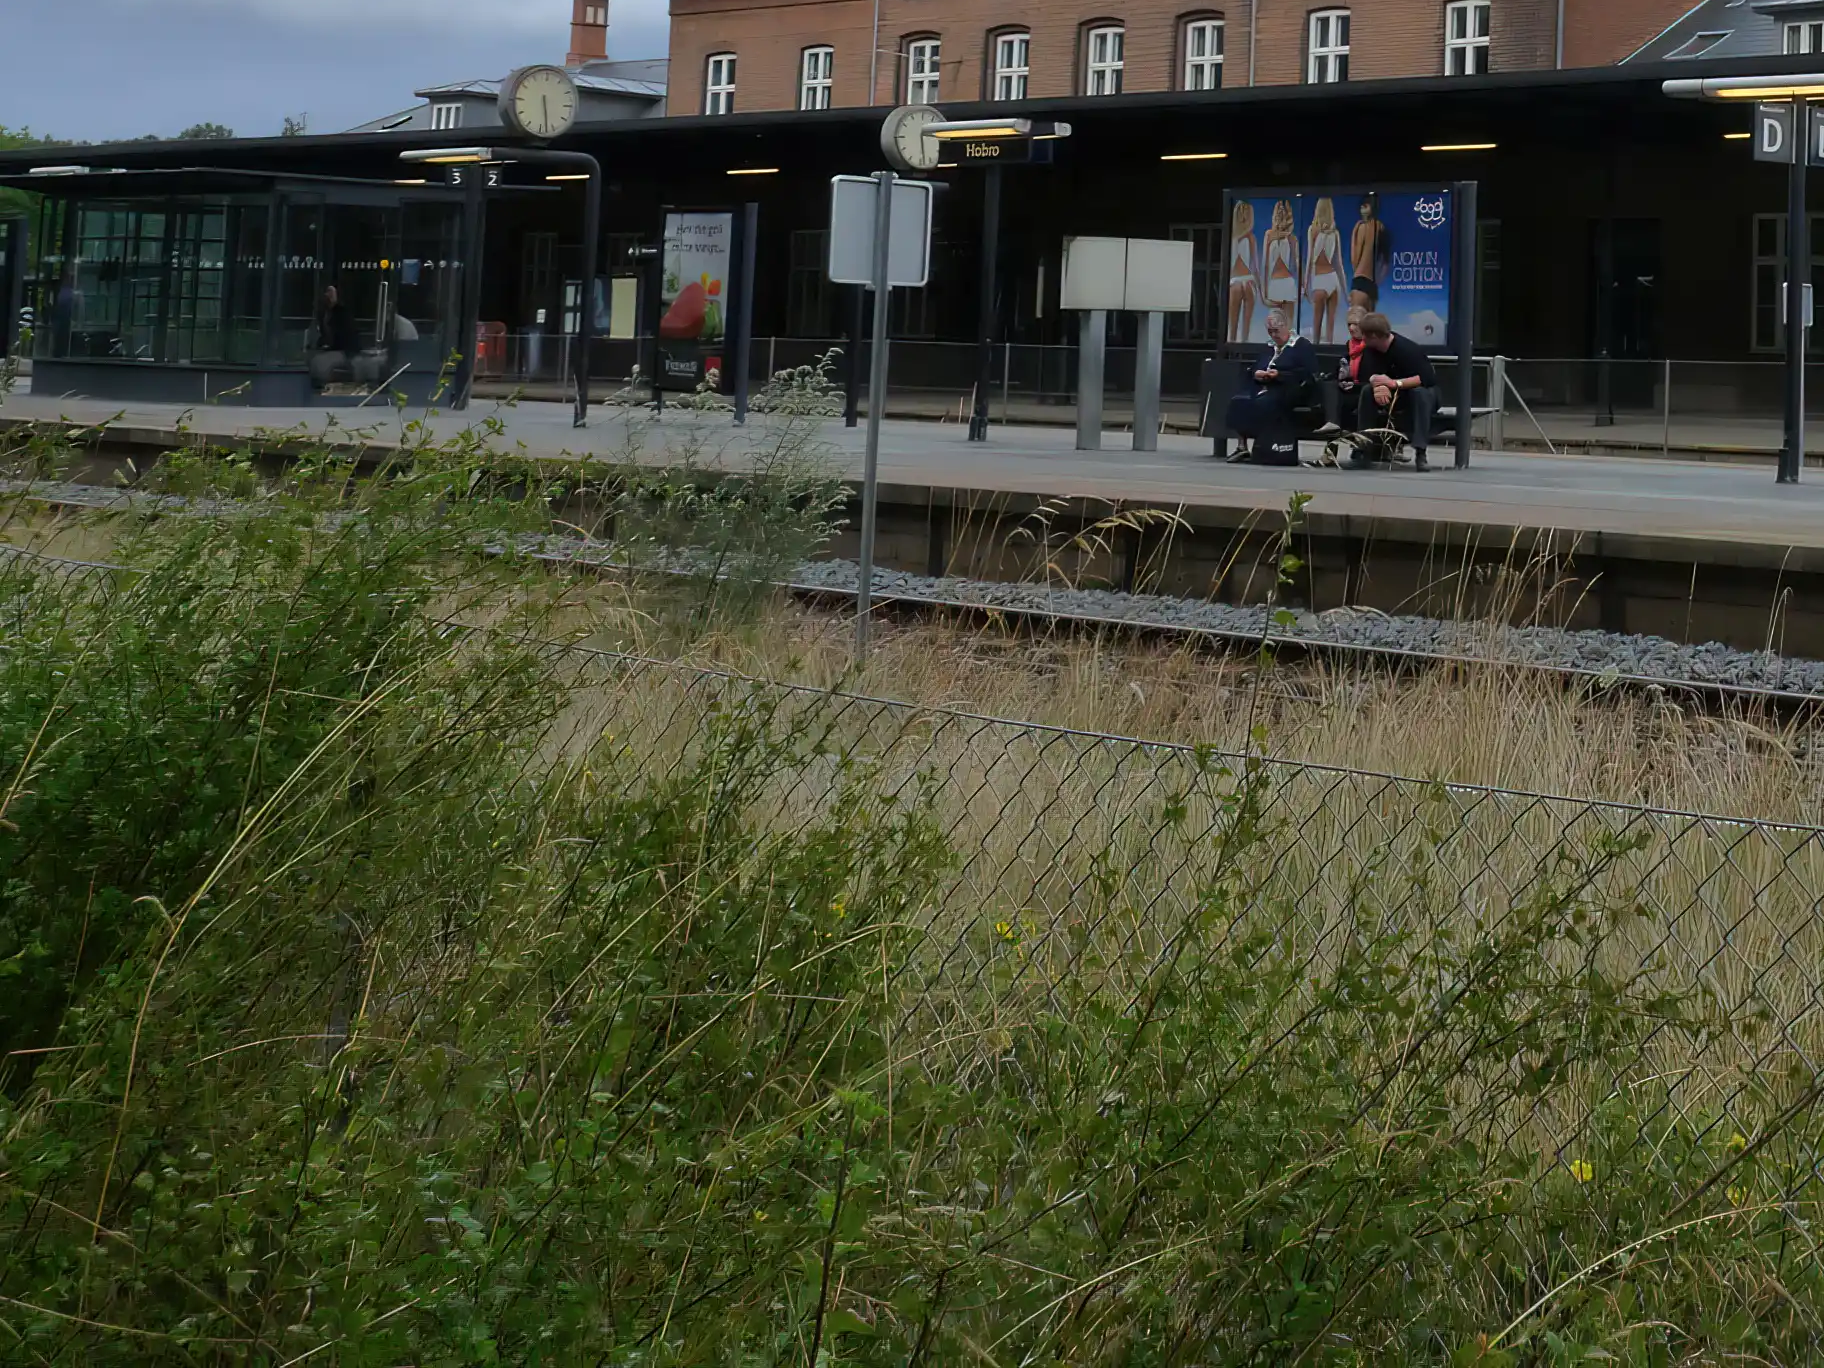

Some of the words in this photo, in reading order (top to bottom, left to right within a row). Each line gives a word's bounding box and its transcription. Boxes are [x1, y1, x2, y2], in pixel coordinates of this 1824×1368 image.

[1763, 118, 1783, 152] D
[966, 143, 1000, 157] Hobro
[452, 172, 461, 184] 3
[488, 174, 498, 186] 2
[1393, 251, 1423, 266] NOW
[1425, 251, 1438, 265] IN
[1393, 267, 1443, 282] COTTON
